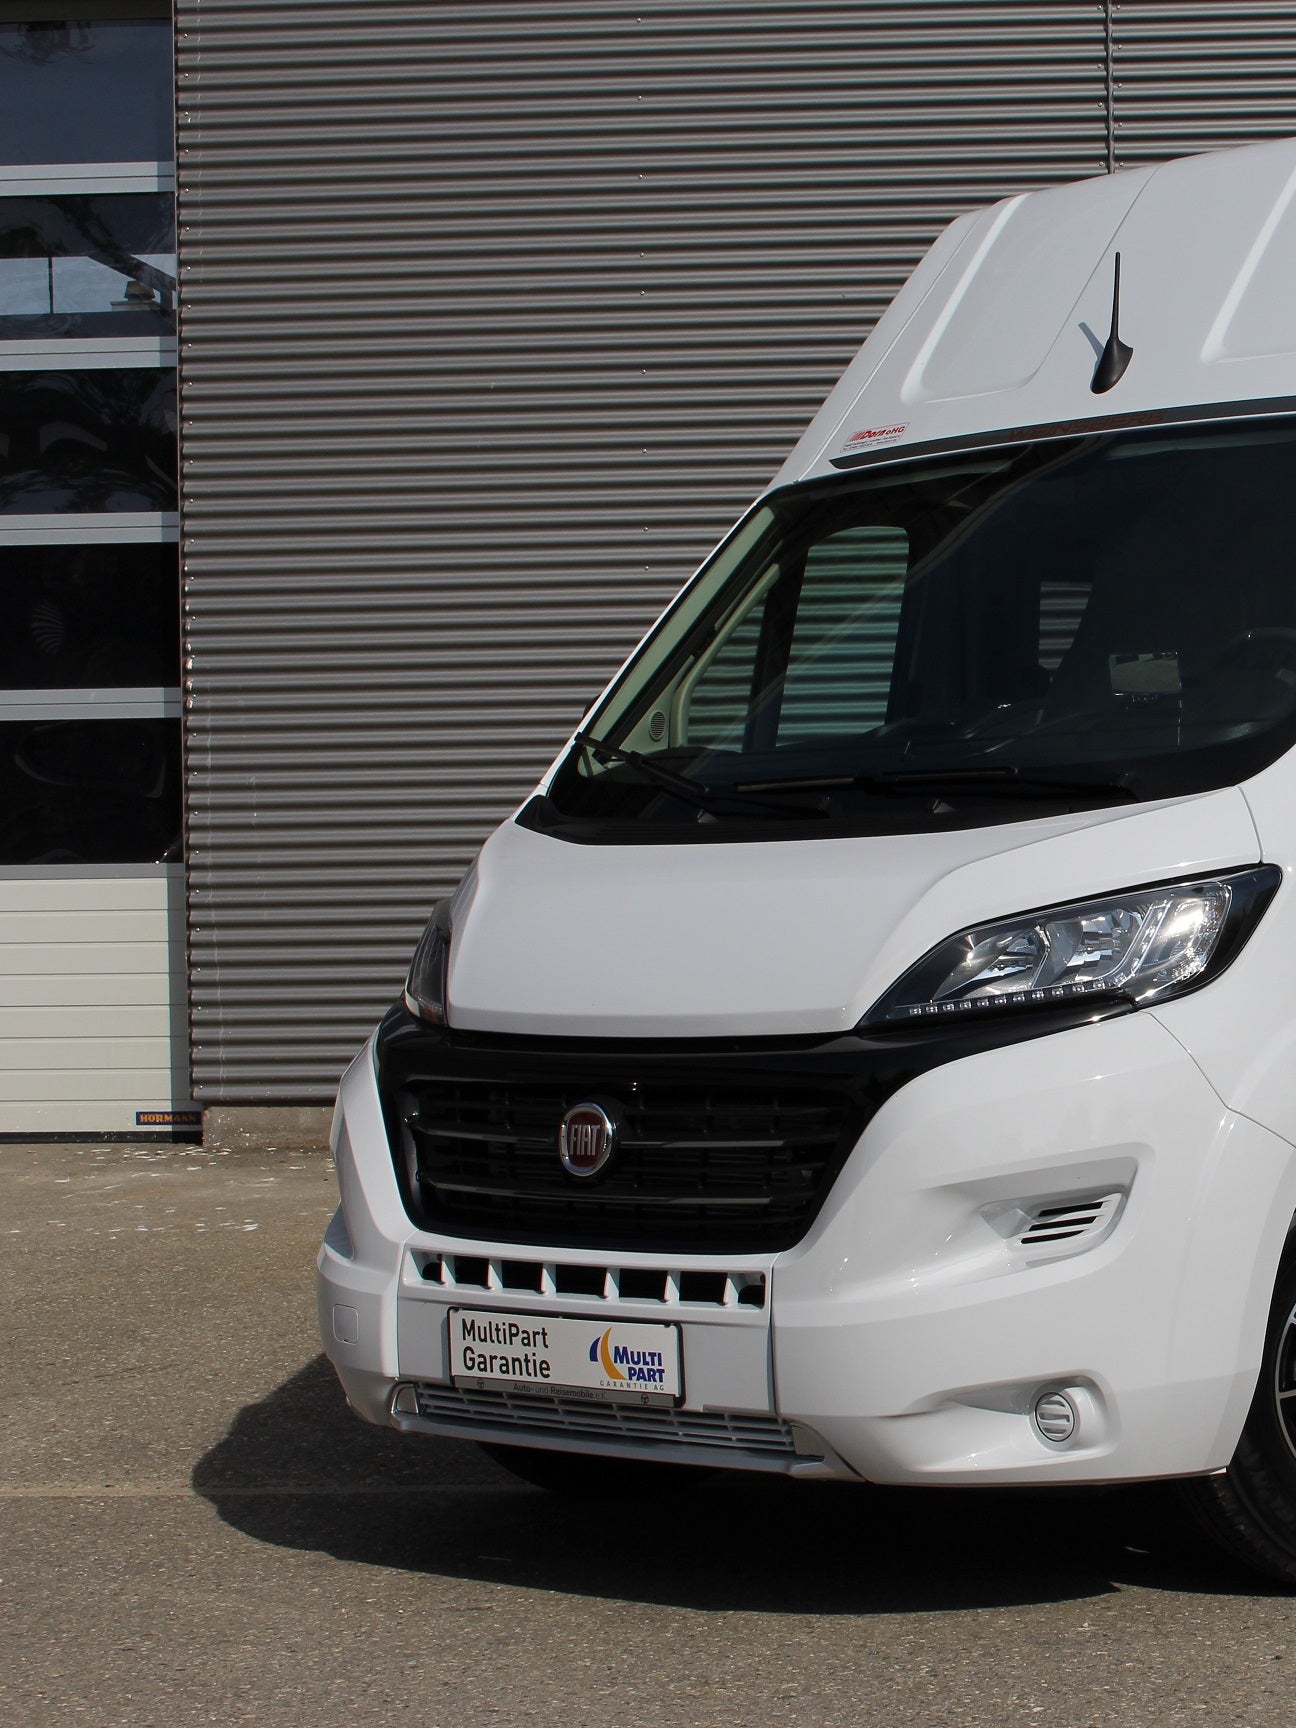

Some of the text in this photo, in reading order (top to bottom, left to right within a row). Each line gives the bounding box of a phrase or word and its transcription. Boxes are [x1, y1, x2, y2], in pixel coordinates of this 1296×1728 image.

[1008, 410, 1168, 442] WEINSBERG
[569, 1124, 601, 1156] FIAT
[461, 1318, 549, 1349] MultiPart
[462, 1345, 552, 1379] Garantie
[613, 1345, 663, 1367] MULTI
[599, 1380, 649, 1391] GARANTIE
[627, 1366, 666, 1383] PART
[513, 1383, 535, 1393] Auto-
[550, 1385, 594, 1399] Reisemobile
